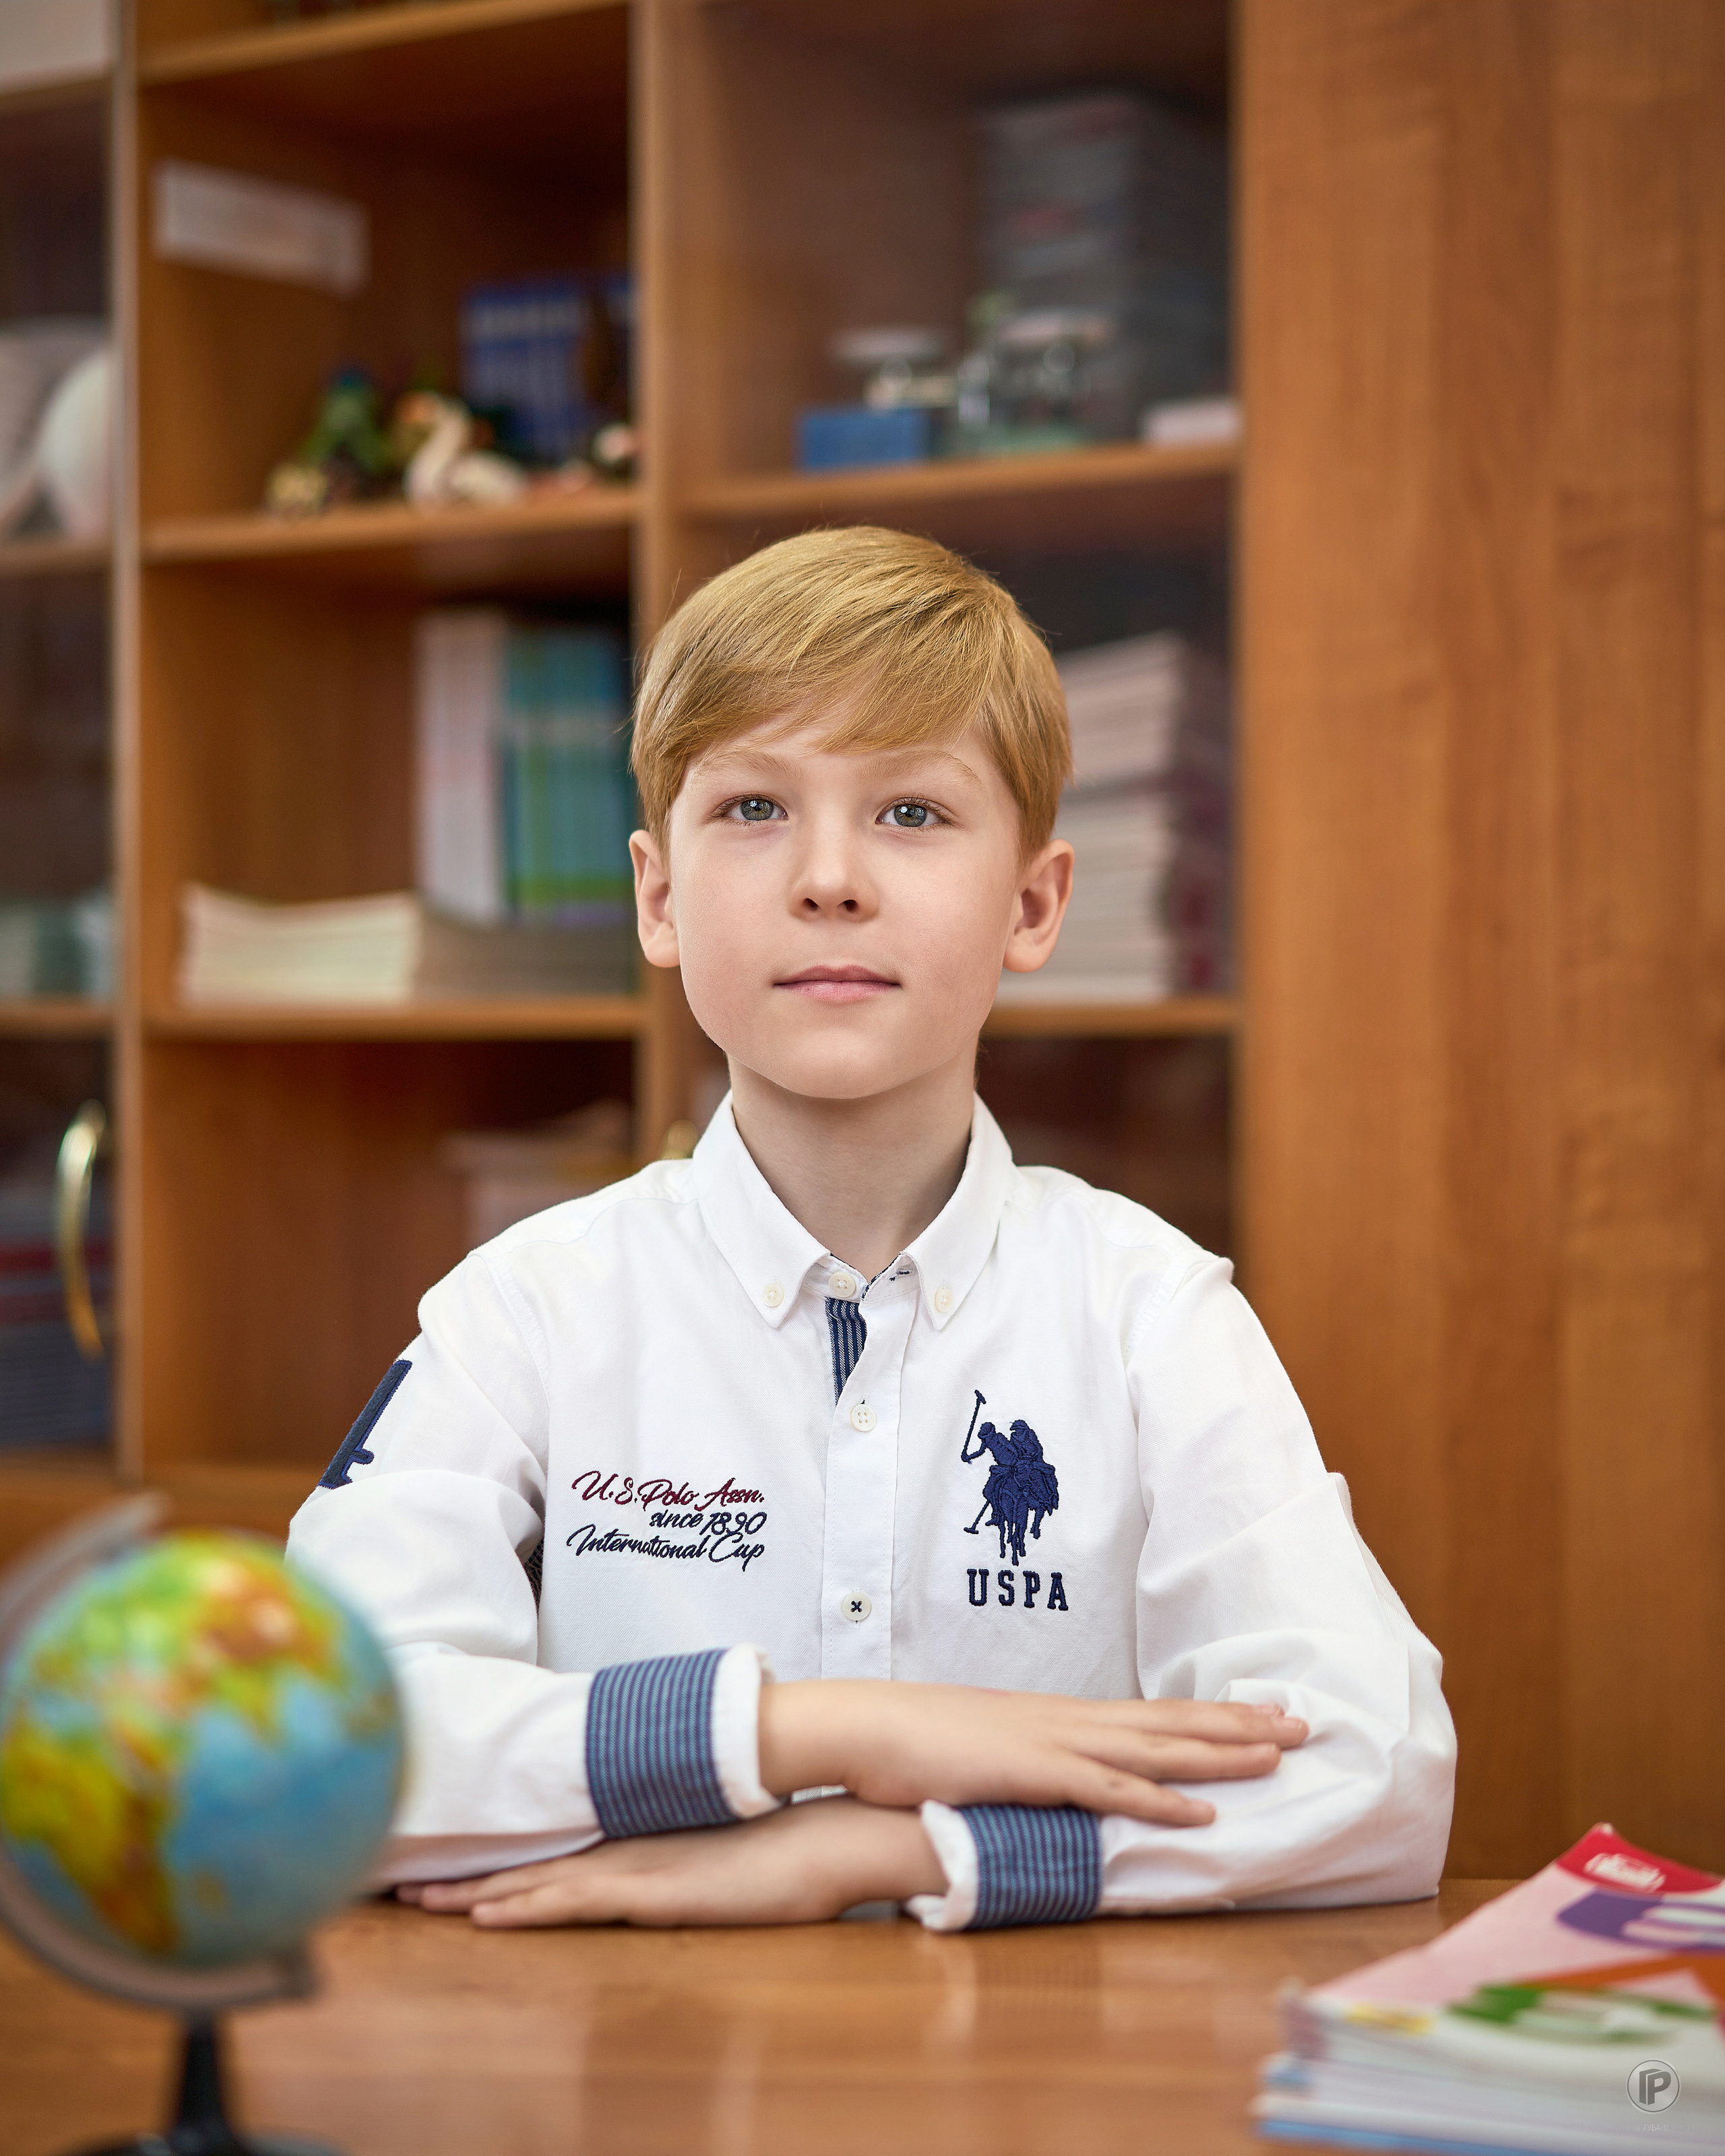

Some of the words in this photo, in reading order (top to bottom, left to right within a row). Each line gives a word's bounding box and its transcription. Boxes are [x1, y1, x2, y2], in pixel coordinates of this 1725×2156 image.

[693, 1477, 765, 1512] Assn.
[648, 1509, 704, 1529] since
[699, 1511, 767, 1535] 1890
[565, 1523, 712, 1559] International
[708, 1531, 765, 1573] Cup
[966, 1568, 1069, 1612] USPA
